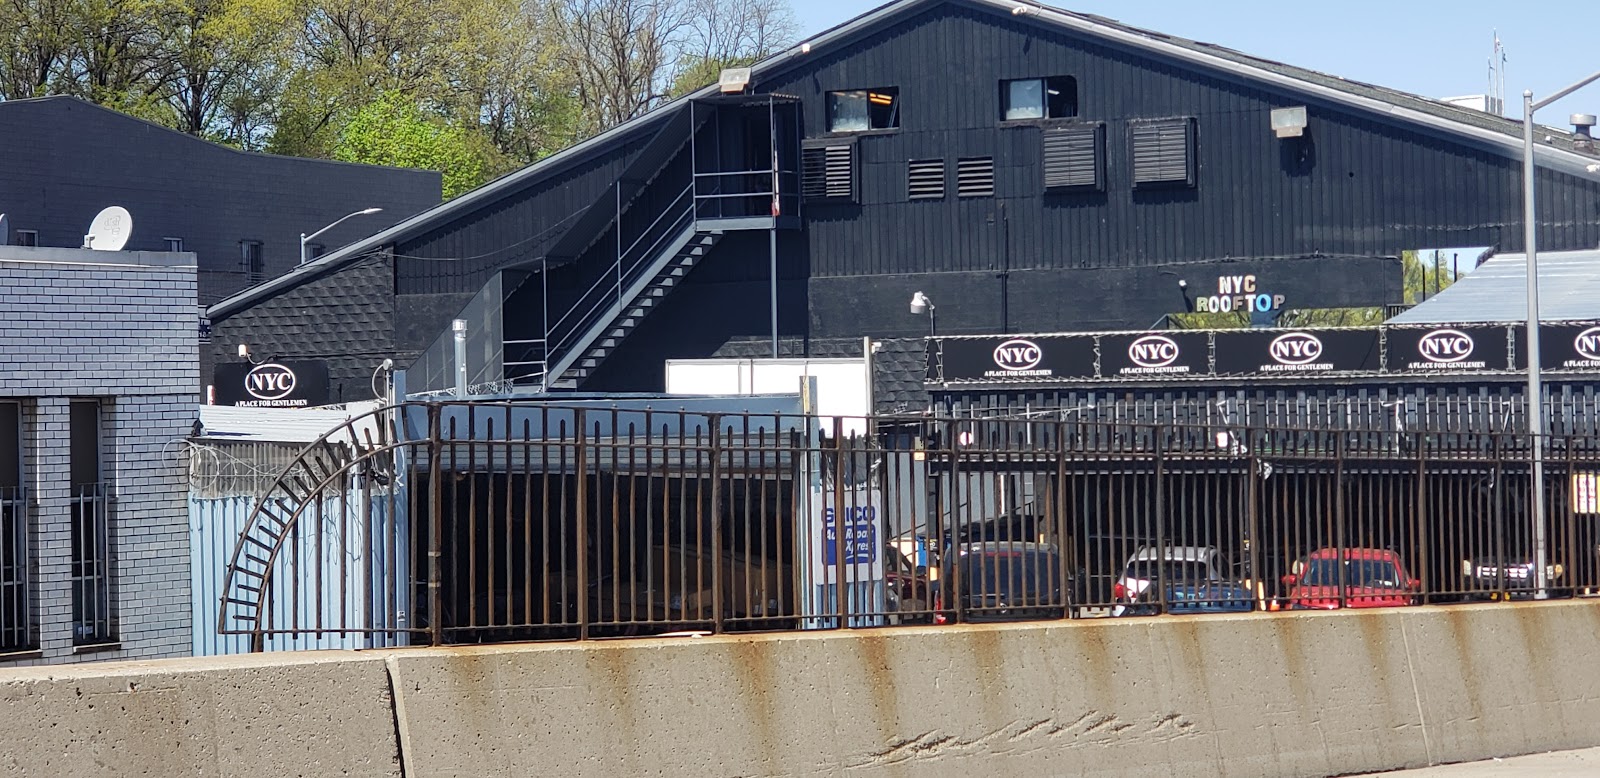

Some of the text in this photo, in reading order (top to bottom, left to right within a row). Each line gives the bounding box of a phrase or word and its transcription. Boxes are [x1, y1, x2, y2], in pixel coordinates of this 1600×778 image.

[1219, 275, 1256, 294] NYC
[1196, 294, 1285, 313] ROOFTOP
[1134, 343, 1174, 360] NYC
[1276, 340, 1317, 357] NYC
[1425, 337, 1468, 354] NYC
[999, 347, 1037, 363] NYC
[1447, 361, 1486, 369] GENTLEMEN
[250, 373, 291, 391] NYC
[272, 399, 308, 407] GENTLEMEN
[821, 506, 875, 523] GICO
